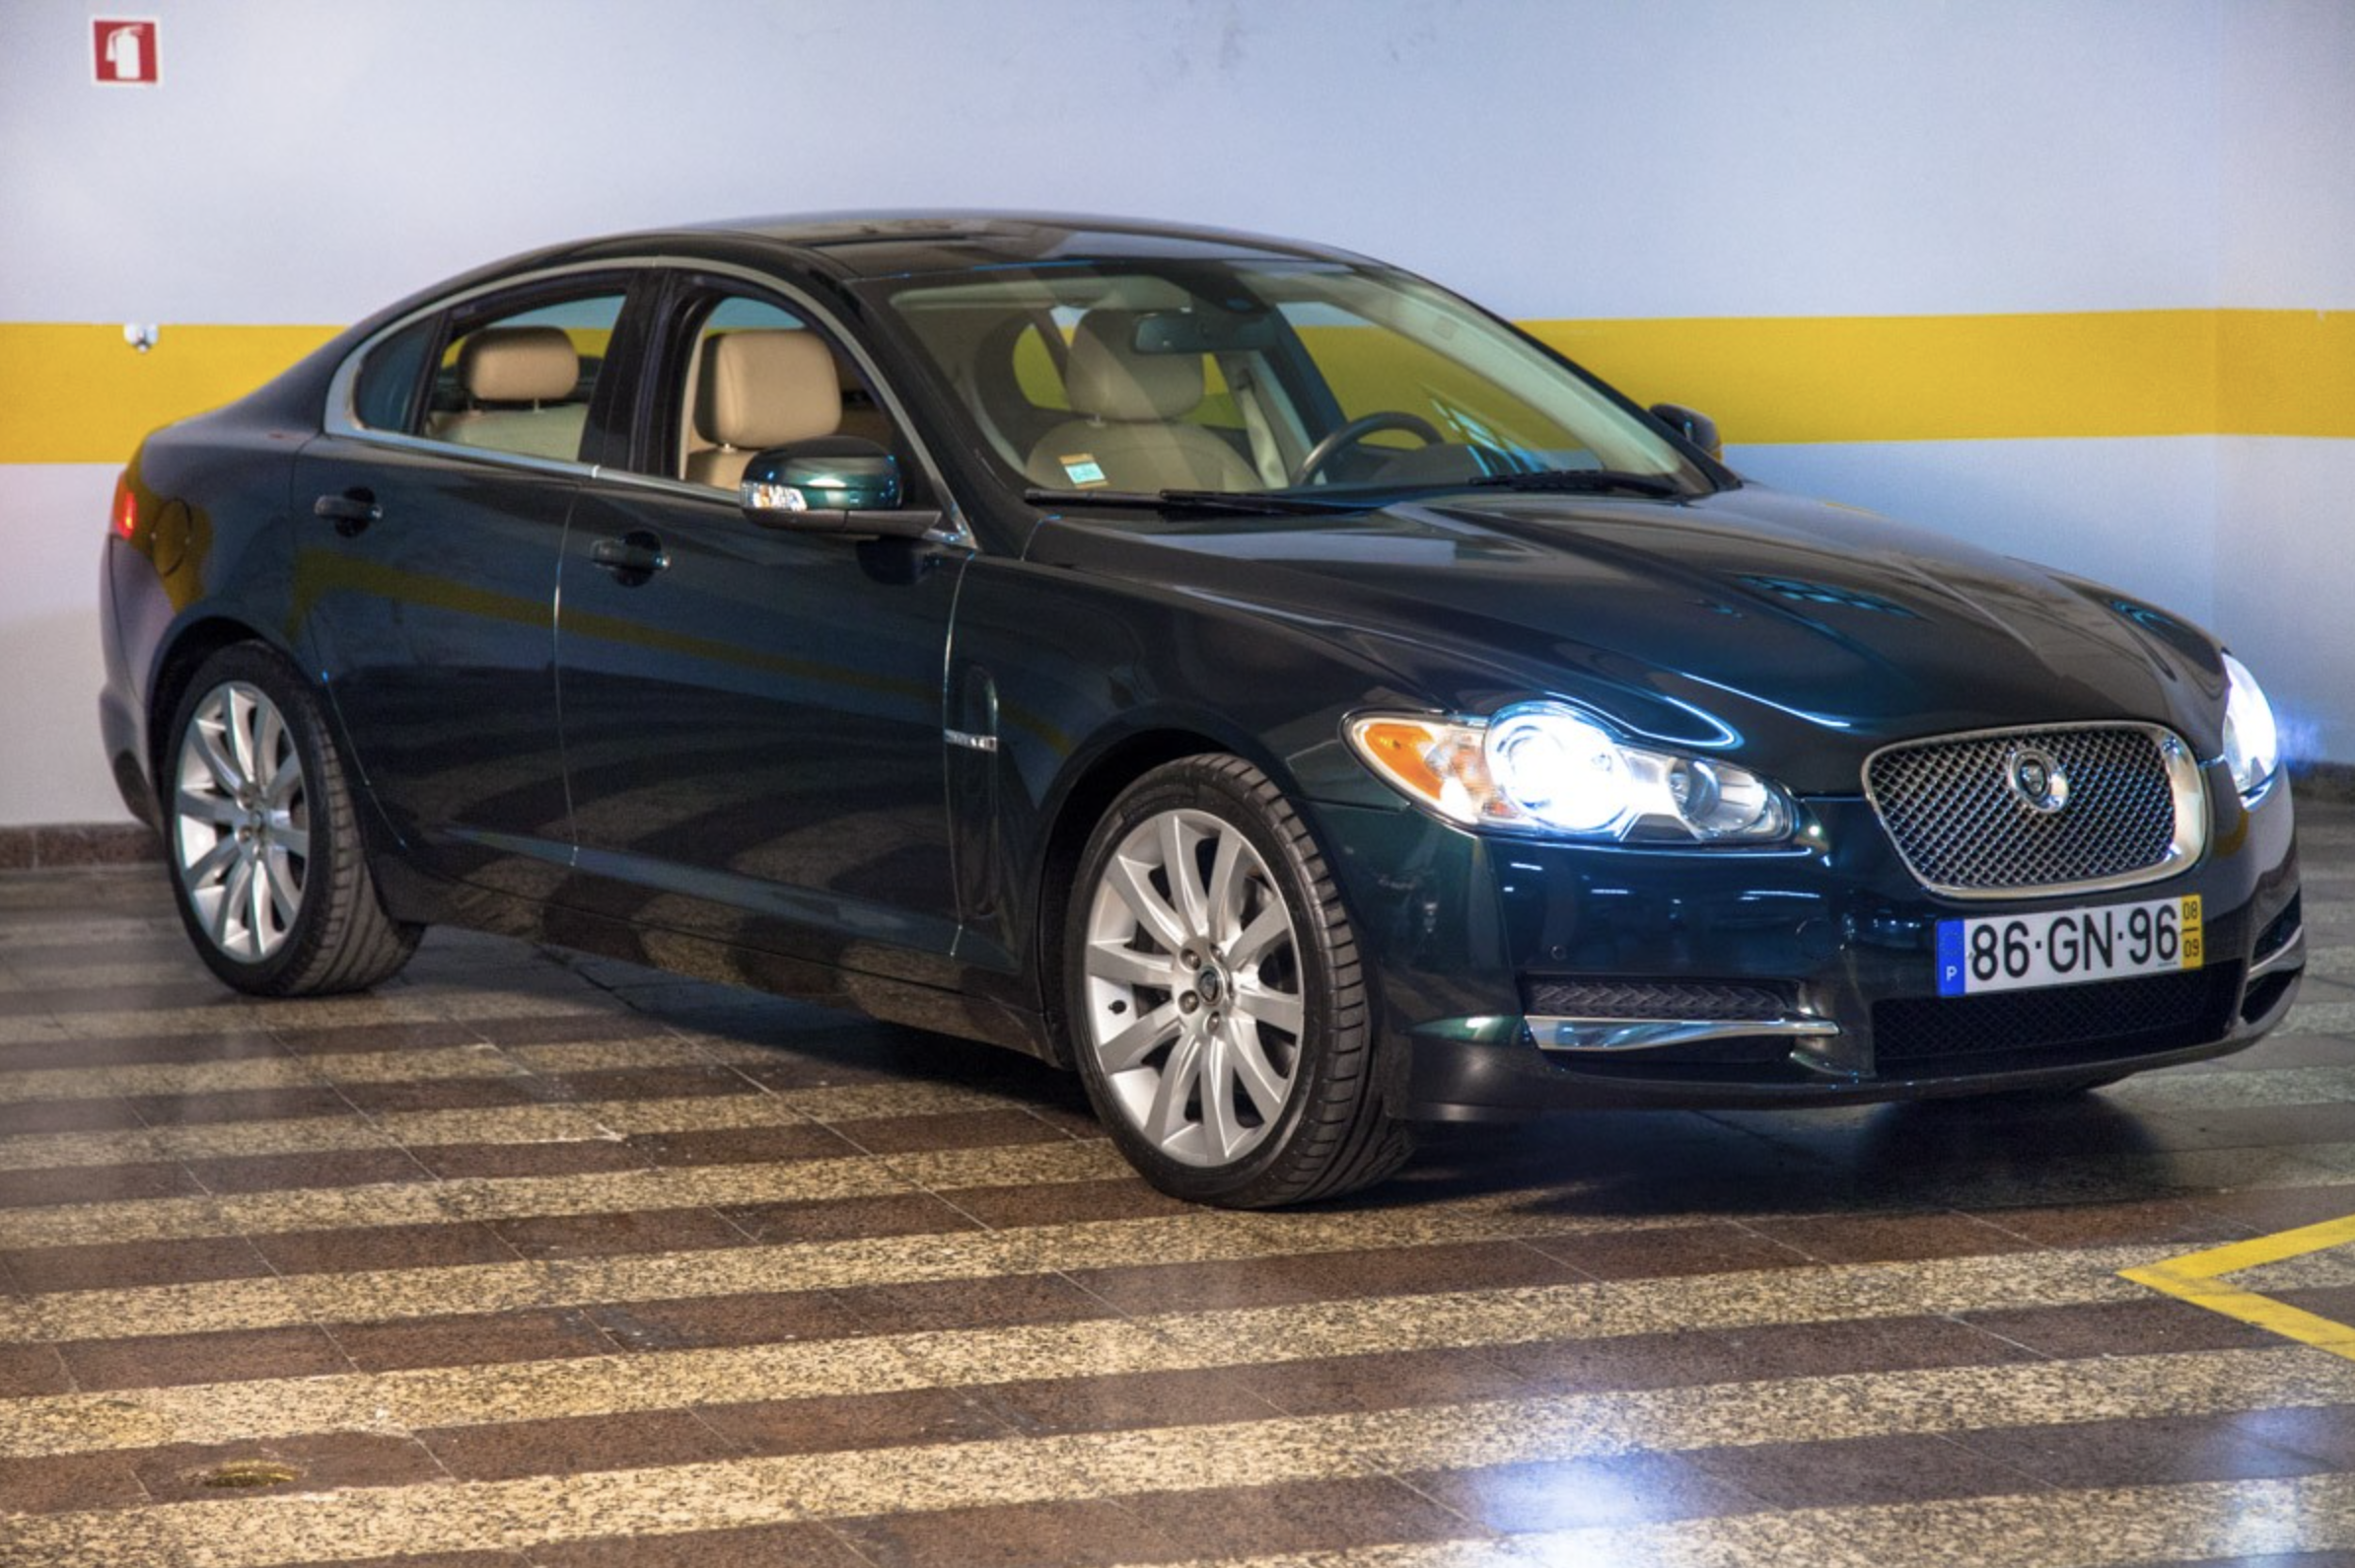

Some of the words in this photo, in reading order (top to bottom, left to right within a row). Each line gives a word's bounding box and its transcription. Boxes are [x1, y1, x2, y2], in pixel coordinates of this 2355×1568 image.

[2182, 901, 2199, 919] 08
[2182, 939, 2200, 959] 09
[1946, 965, 1958, 981] P
